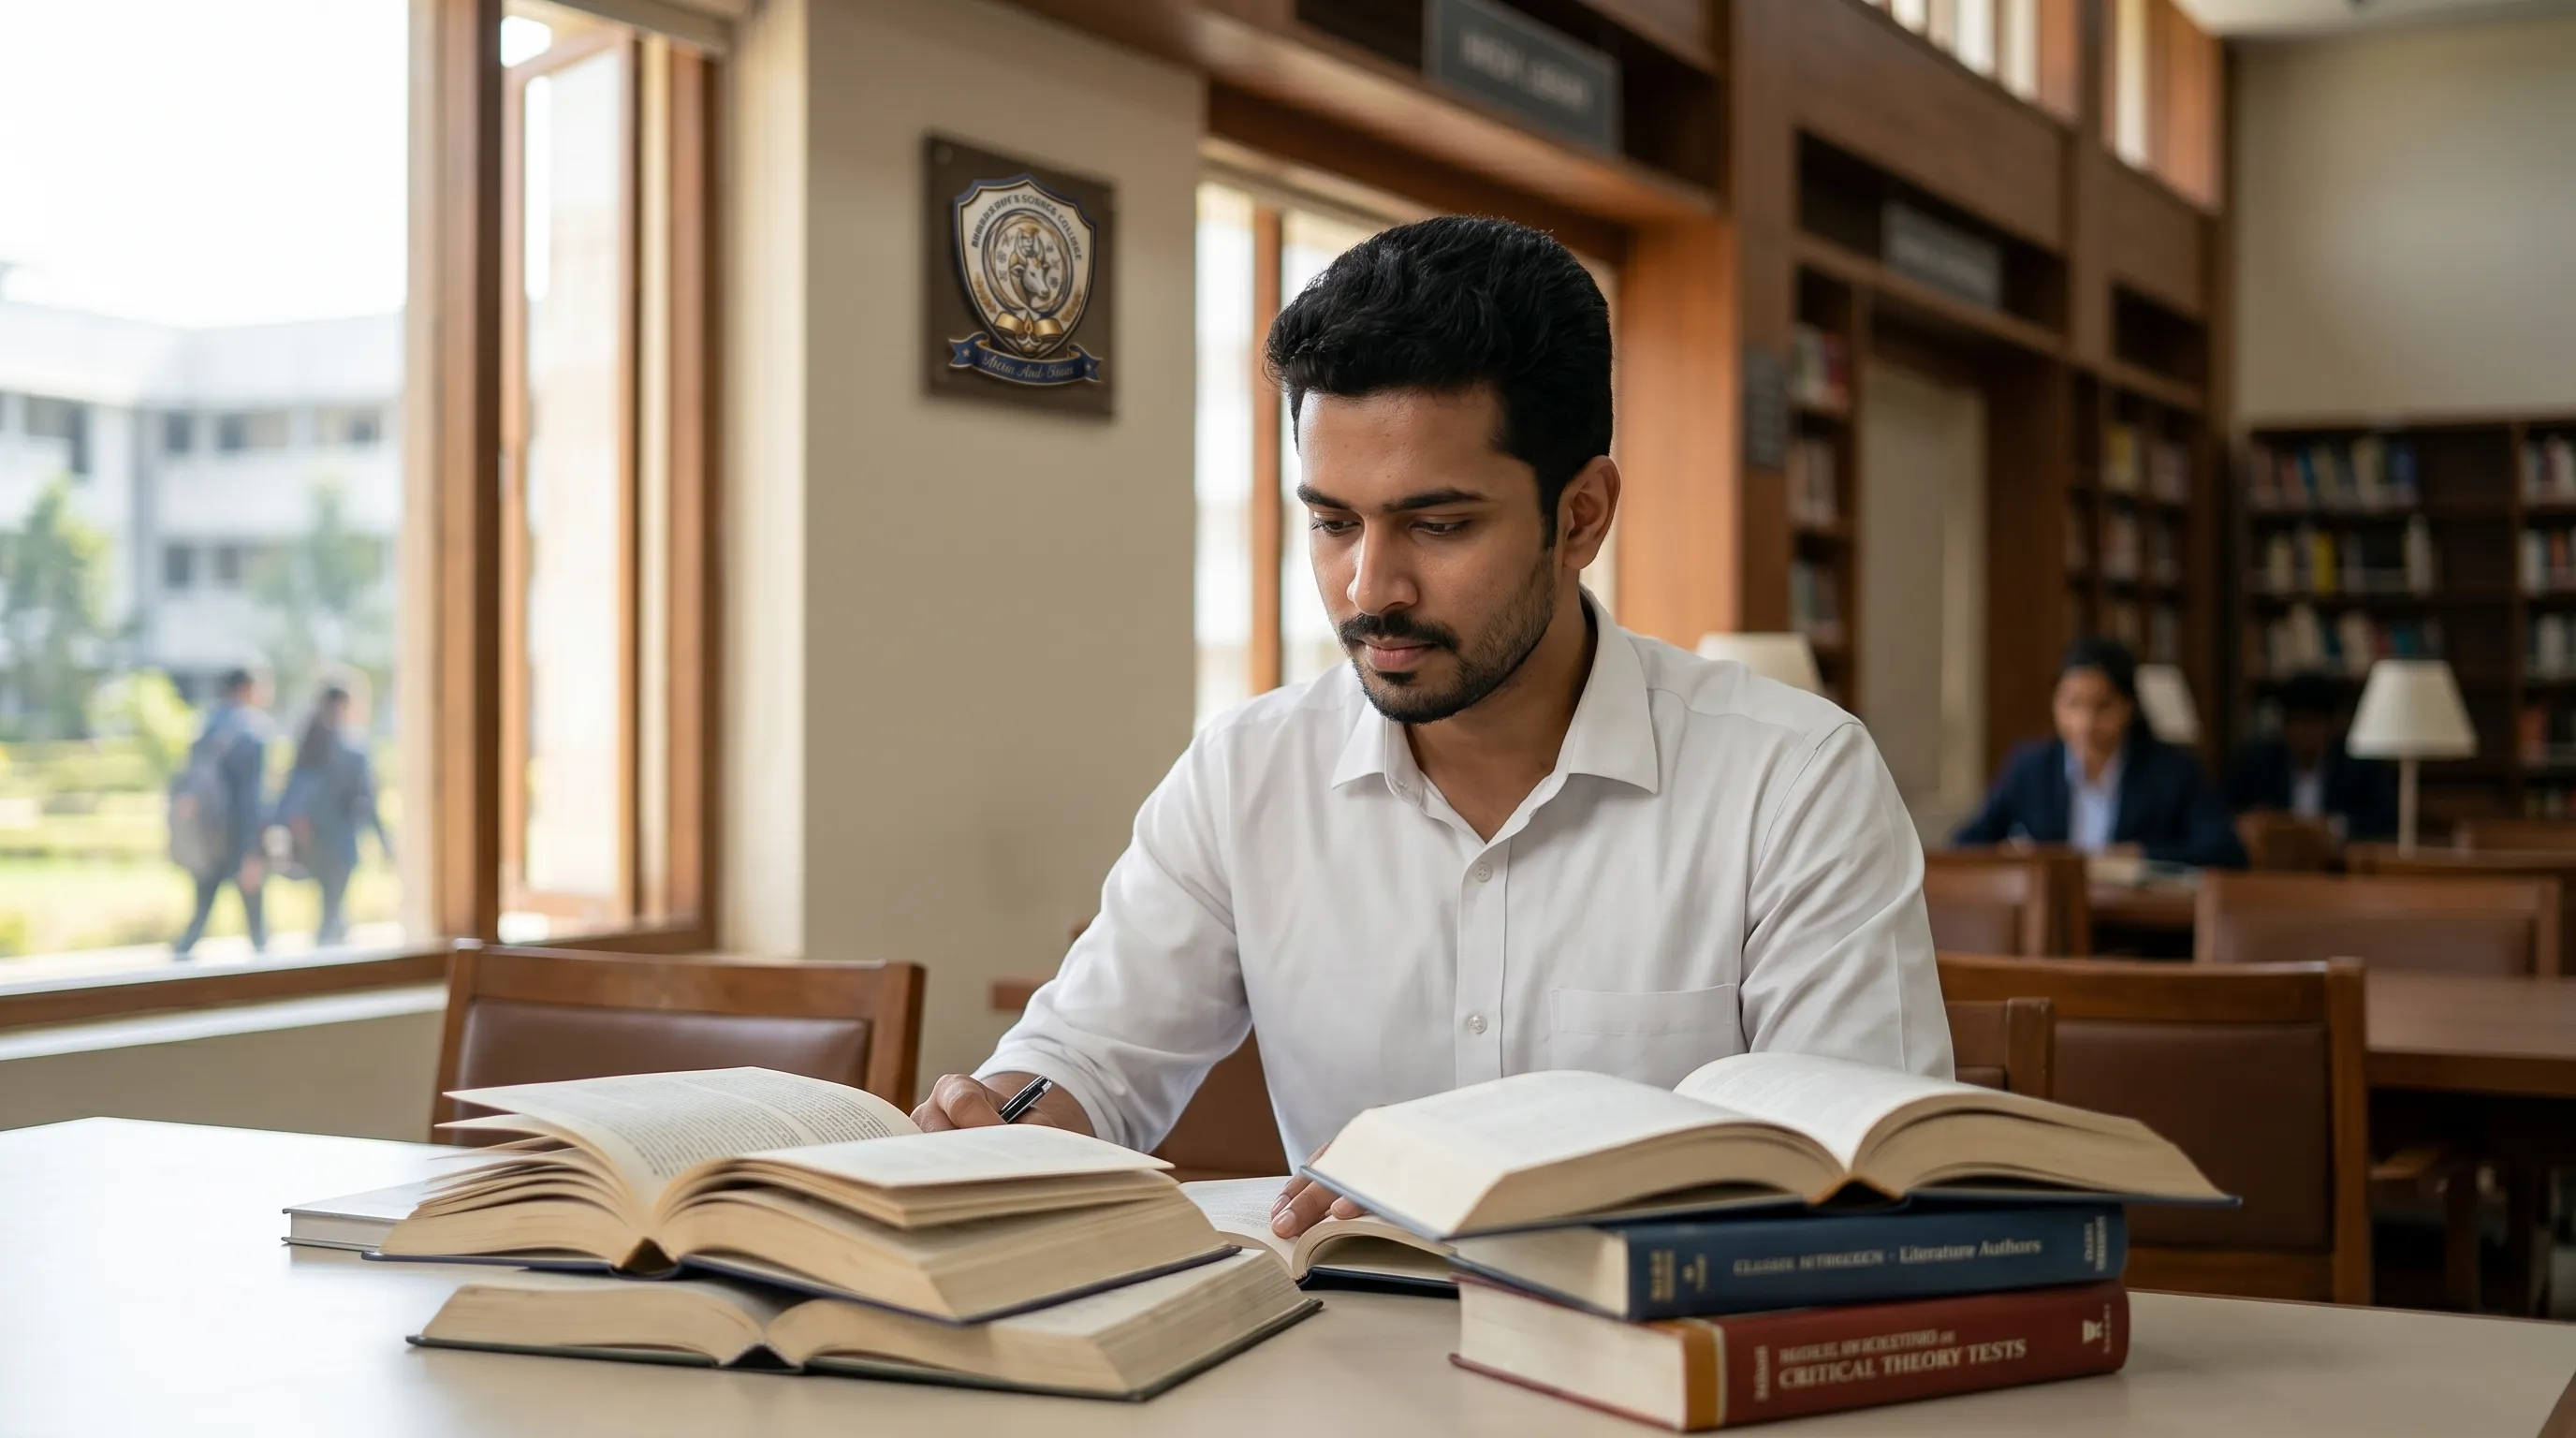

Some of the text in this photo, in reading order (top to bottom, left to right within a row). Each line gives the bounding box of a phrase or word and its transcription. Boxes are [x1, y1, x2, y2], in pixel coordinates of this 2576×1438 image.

[1899, 1244, 1976, 1264] Literature
[1979, 1238, 2042, 1257] Authors
[1778, 1357, 1876, 1389] CRITICAL
[1881, 1346, 1962, 1377] THEORY
[1967, 1338, 2027, 1365] TESTS
